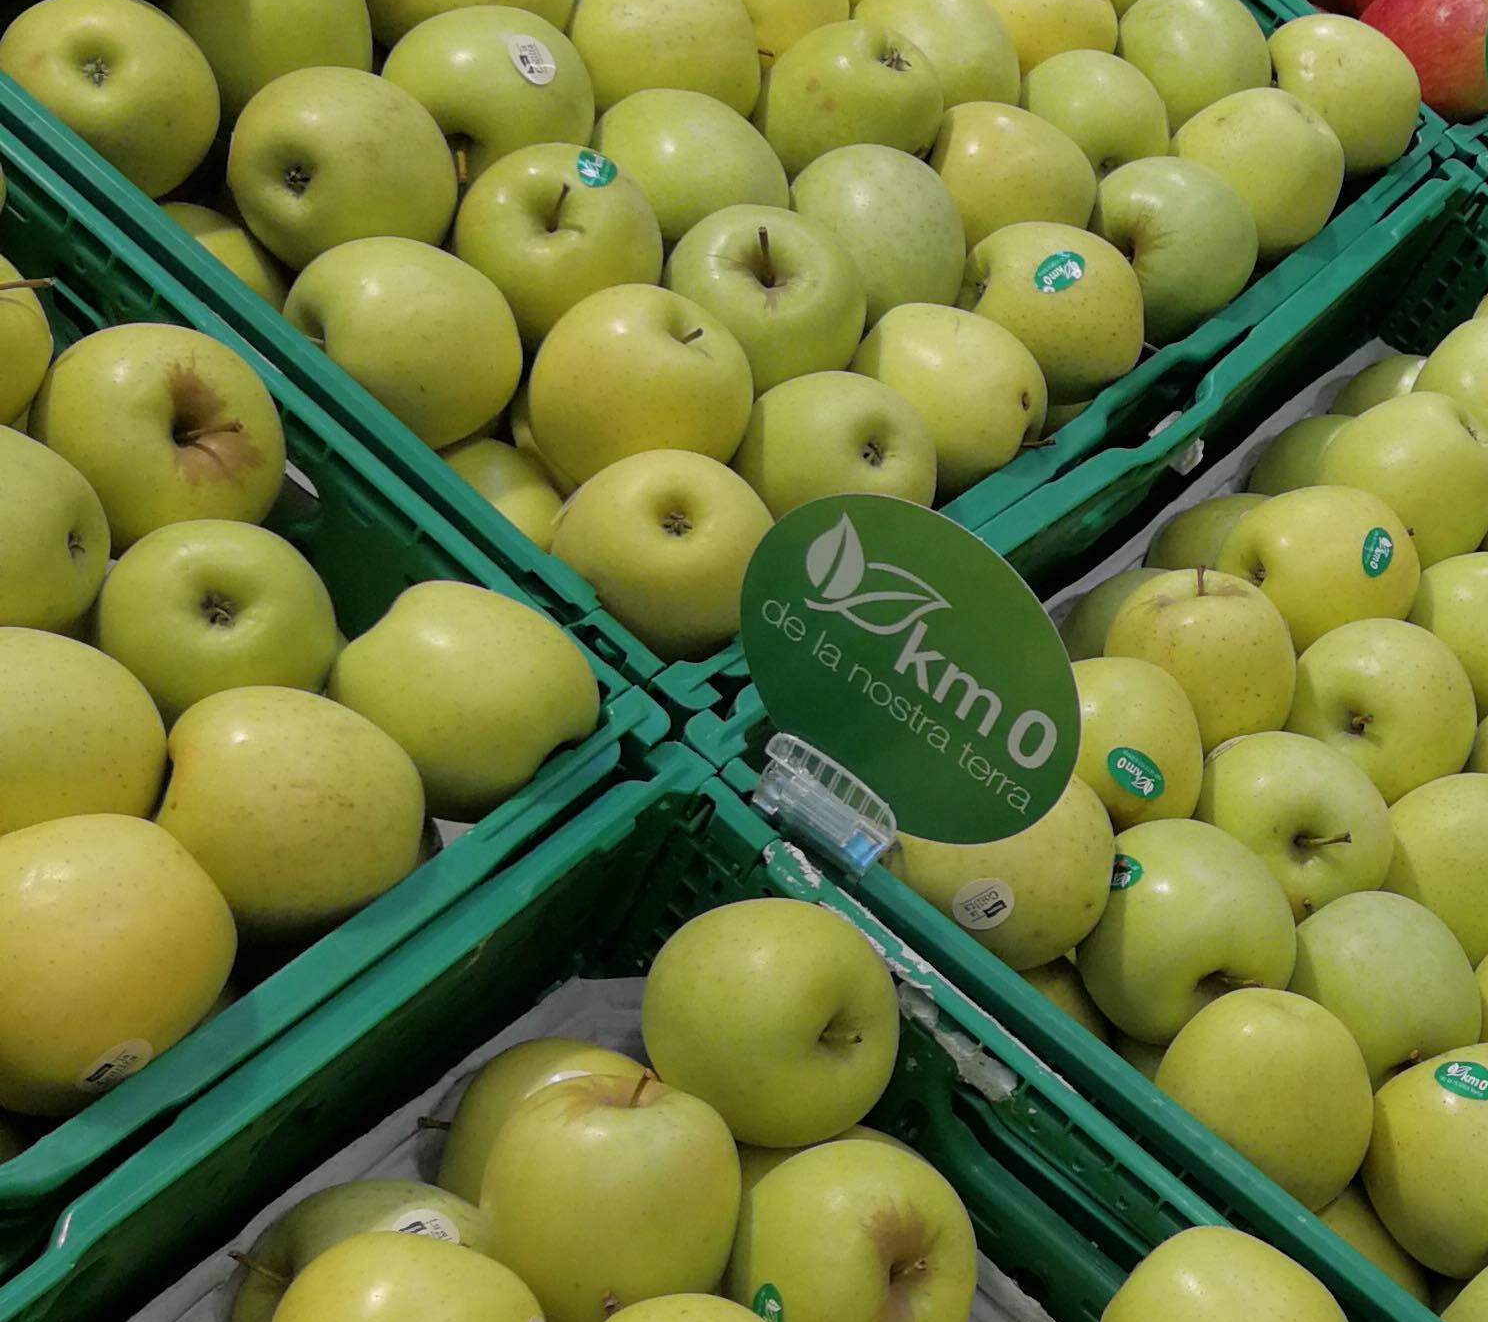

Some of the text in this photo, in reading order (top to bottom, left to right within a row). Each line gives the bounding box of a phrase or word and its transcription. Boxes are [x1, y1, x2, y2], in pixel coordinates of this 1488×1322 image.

[761, 599, 1033, 815] de la nostra terra
